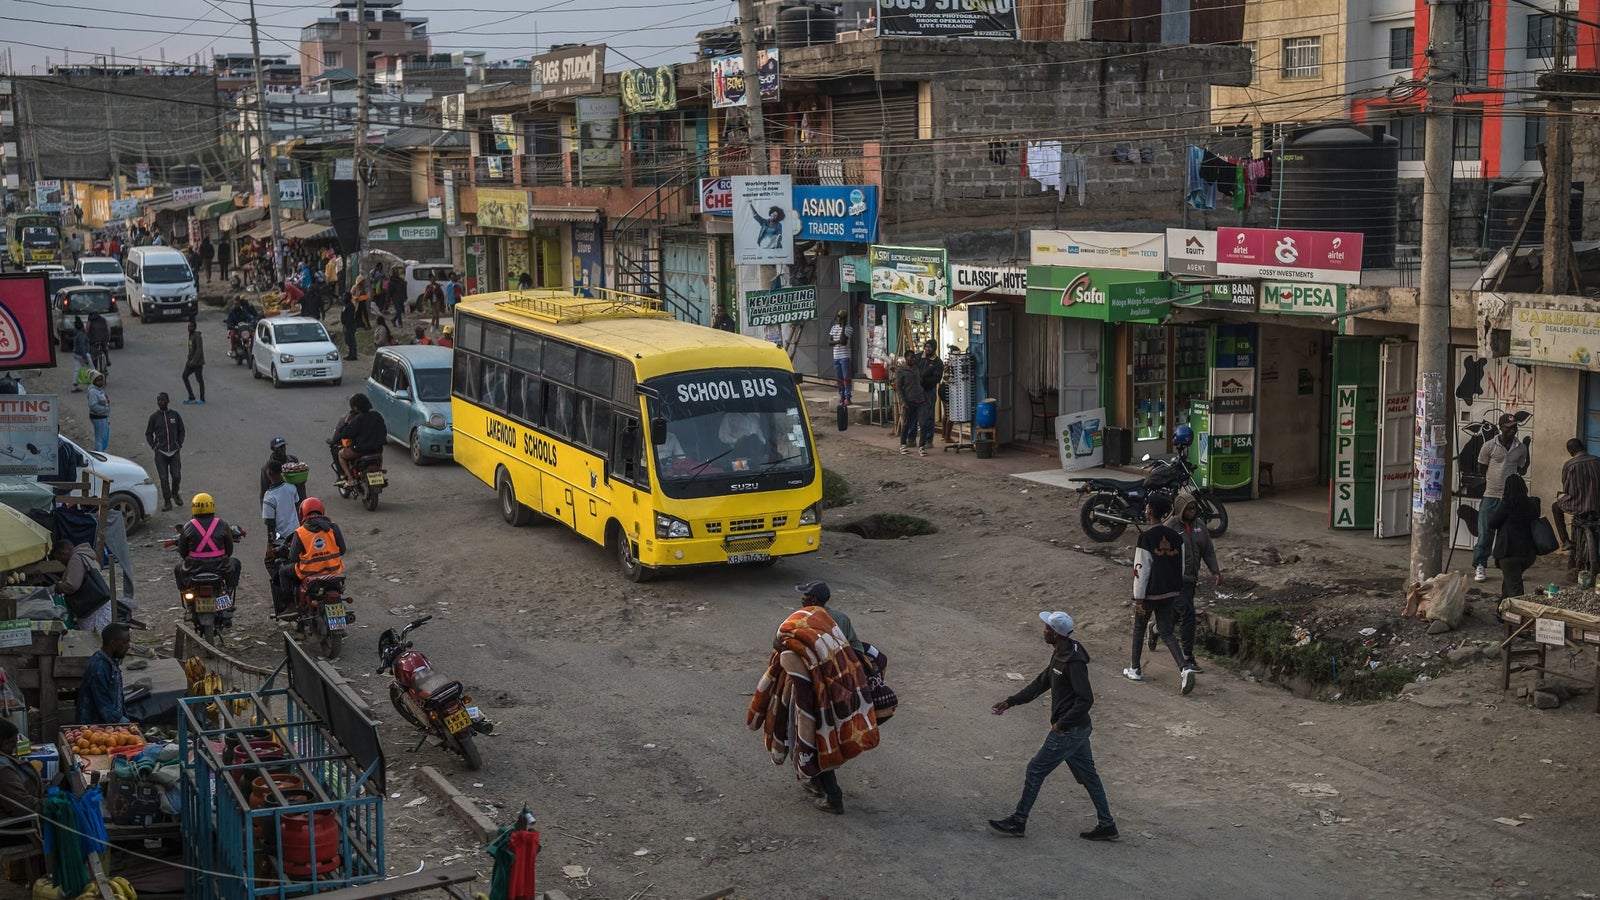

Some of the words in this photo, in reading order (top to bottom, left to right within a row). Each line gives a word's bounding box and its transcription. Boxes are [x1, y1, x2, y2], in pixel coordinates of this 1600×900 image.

[542, 60, 559, 84] UGS
[561, 55, 591, 81] STUDIO
[802, 197, 845, 218] ASANO
[575, 230, 595, 241] General
[808, 223, 845, 239] TRADERS
[577, 241, 592, 253] Store
[1186, 247, 1205, 255] EQUITY
[1233, 246, 1248, 254] airtel
[1327, 251, 1345, 260] airtel
[1186, 263, 1205, 271] AGENT
[958, 270, 999, 287] CLASSIC
[1277, 270, 1314, 279] INVESTMENTS
[1135, 287, 1146, 296] Lipa
[1214, 284, 1228, 294] KCB
[749, 296, 770, 308] KEY
[770, 288, 815, 304] CUTTING
[1232, 295, 1254, 304] AGENT
[752, 304, 790, 315] AVAILABLE
[1130, 307, 1150, 316] Available
[752, 310, 815, 326] 0793003791
[1518, 310, 1590, 327] CARESIL
[1545, 325, 1570, 333] DEALERS
[677, 380, 740, 403] SCHOOL
[741, 377, 778, 398] BUS
[1386, 396, 1410, 405] FRESH
[1387, 405, 1409, 413] MILK
[486, 416, 517, 448] LAKEWOOD
[524, 432, 557, 467] SCHOOLS
